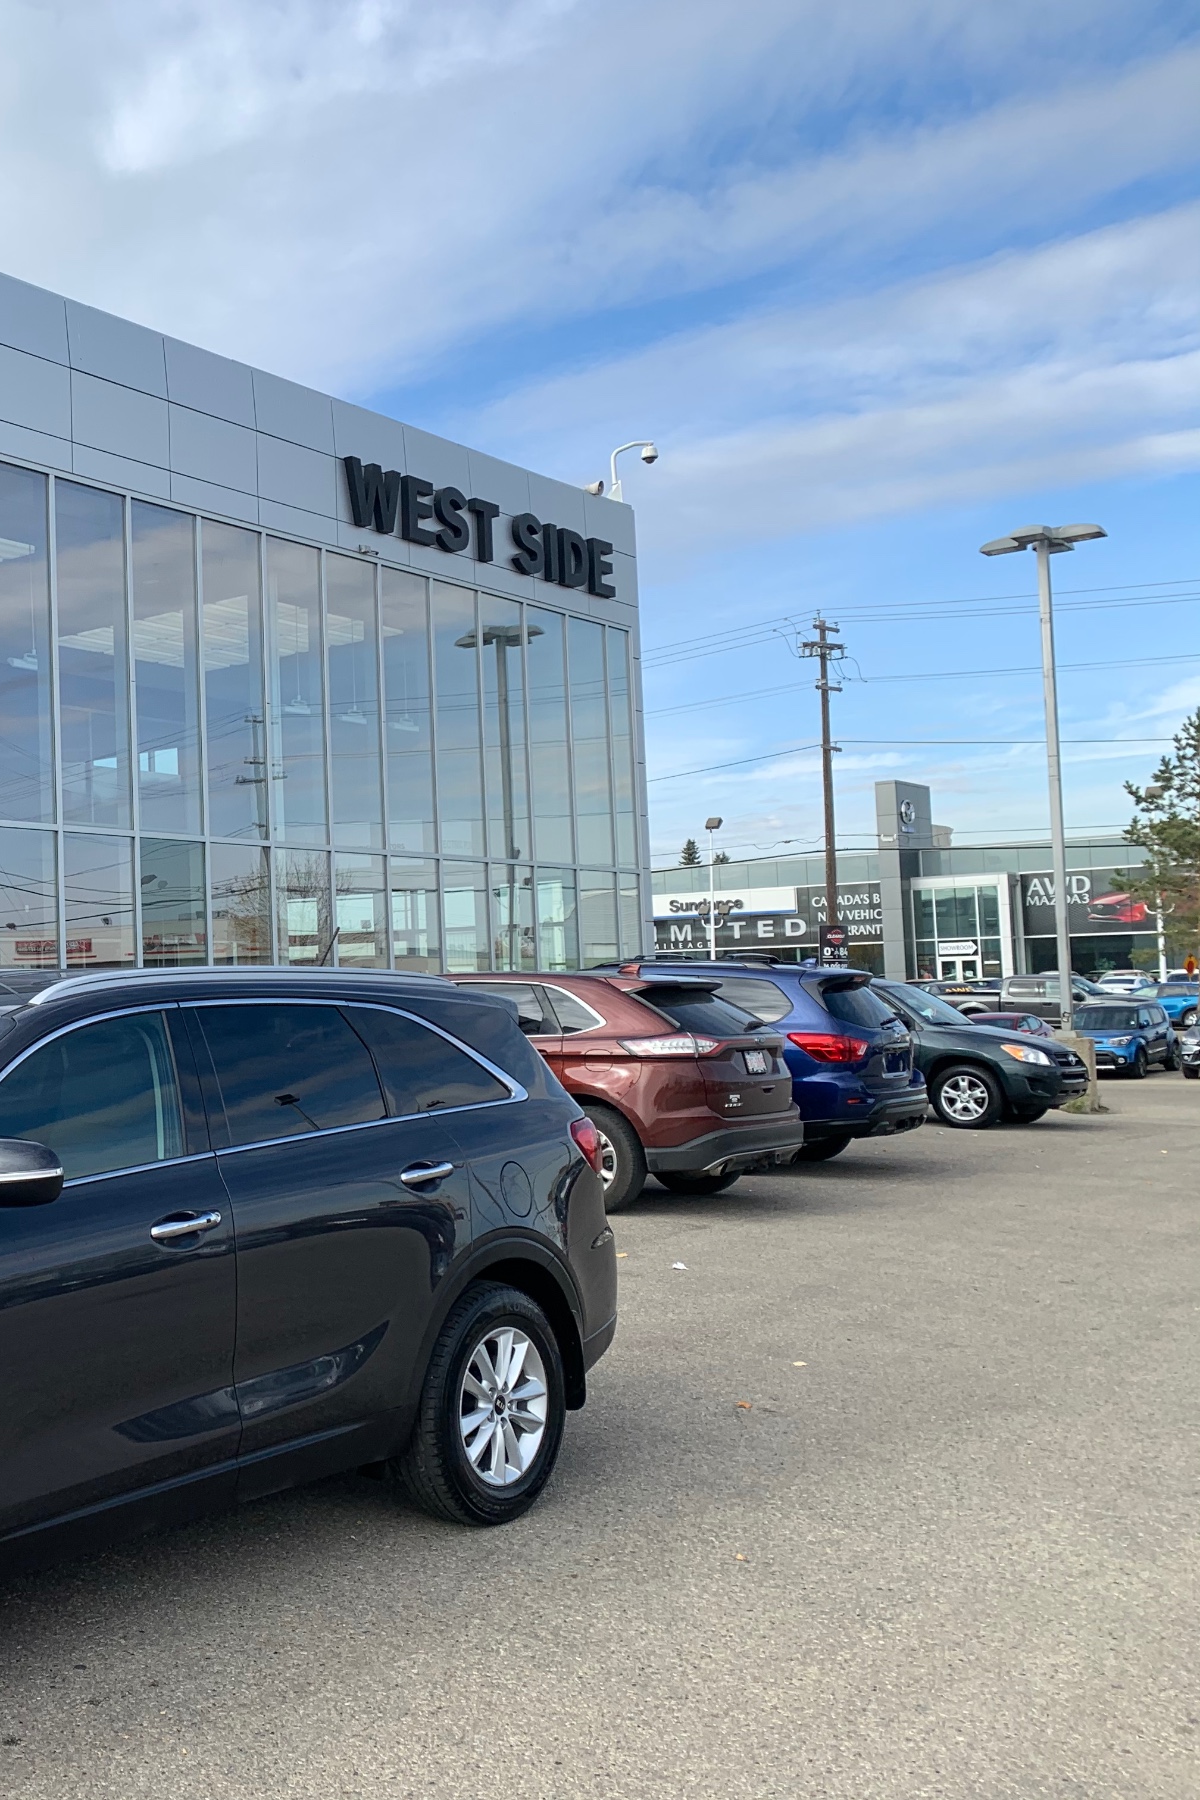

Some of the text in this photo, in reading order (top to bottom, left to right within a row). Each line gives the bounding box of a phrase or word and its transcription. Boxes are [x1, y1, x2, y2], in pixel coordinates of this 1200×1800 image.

[343, 455, 616, 599] WEST SIDE
[1027, 875, 1091, 896] AWD
[811, 894, 870, 907] CAADA'S
[818, 908, 883, 922] NW VEHIC
